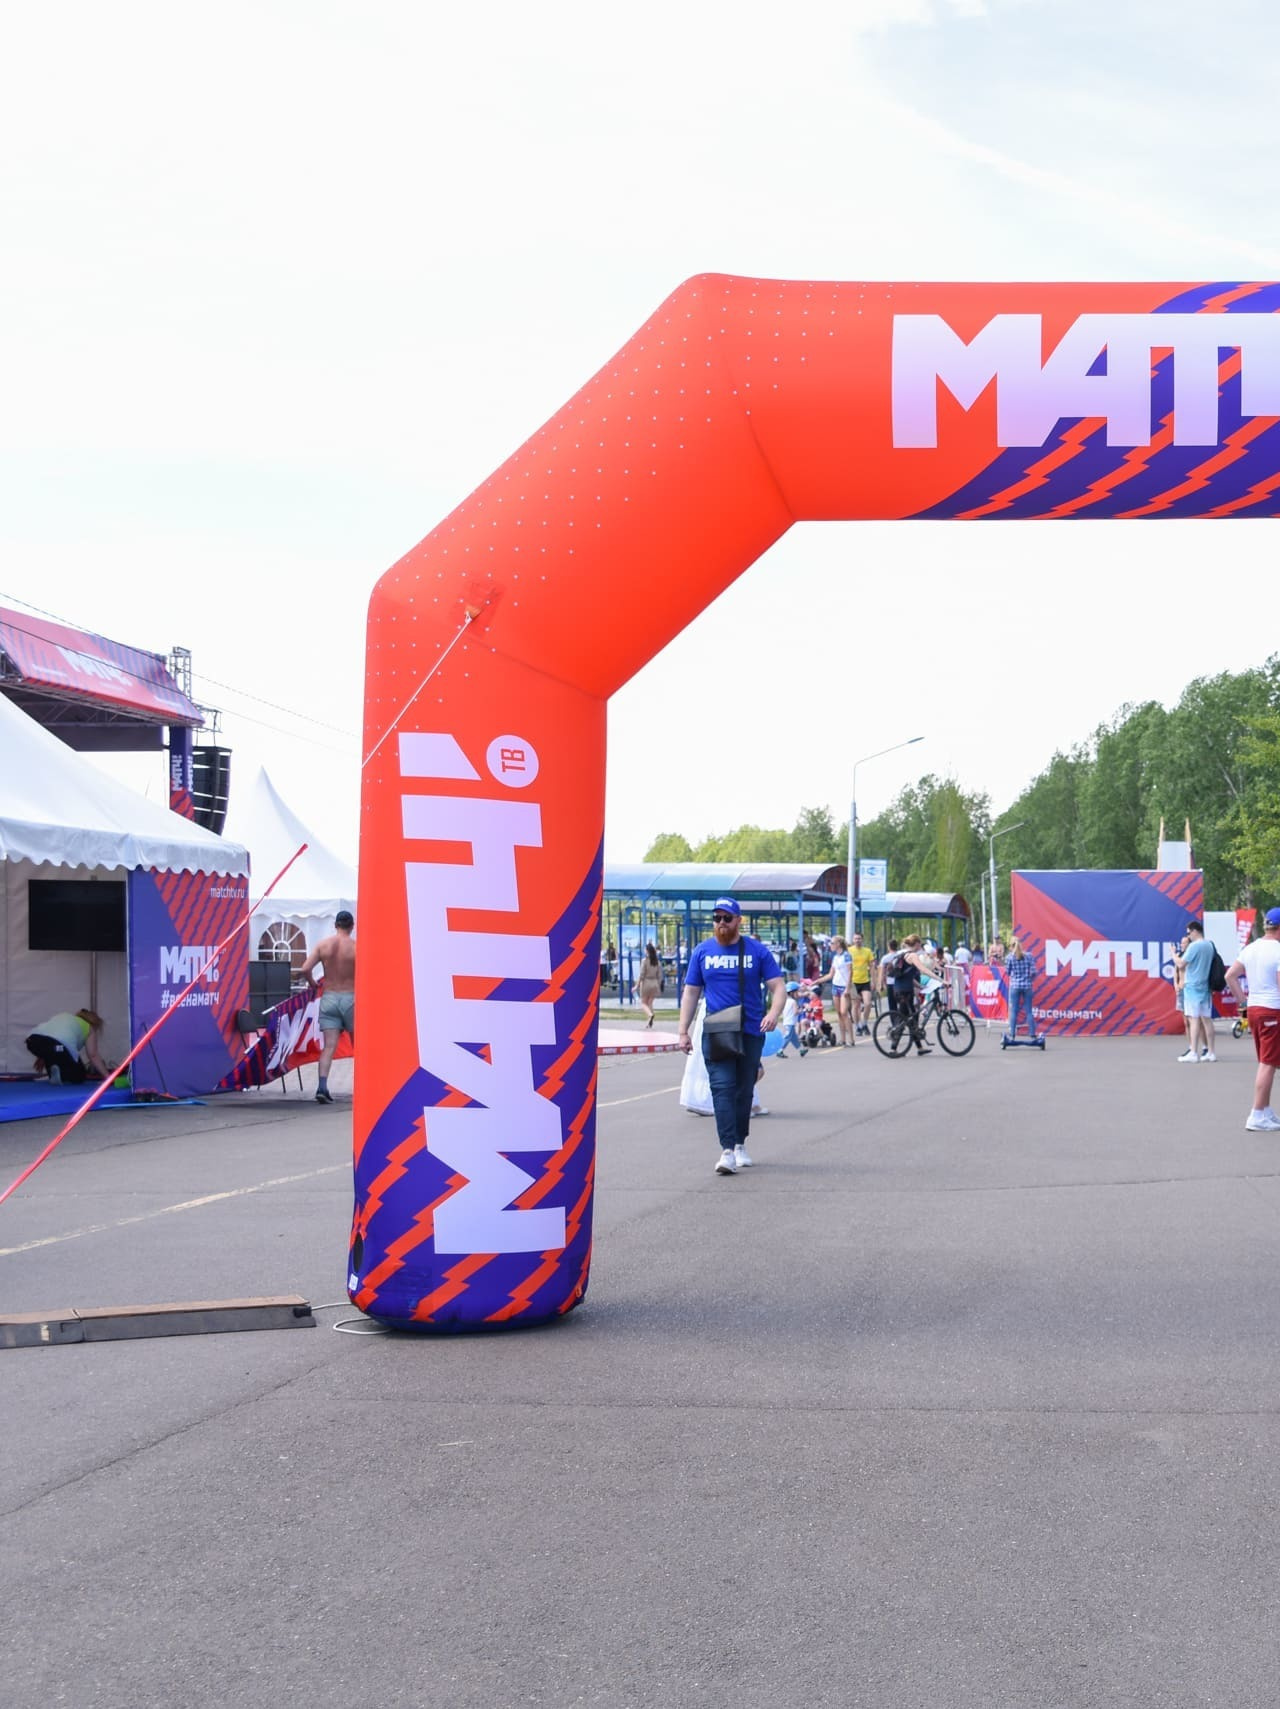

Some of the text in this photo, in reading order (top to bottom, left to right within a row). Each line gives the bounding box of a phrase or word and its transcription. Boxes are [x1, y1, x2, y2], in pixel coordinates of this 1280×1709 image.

[501, 748, 526, 773] ТВ
[210, 887, 245, 898] matchtv.ru
[160, 946, 219, 984] МАТЧ!
[1045, 939, 1175, 979] МАТЧ!
[398, 732, 566, 1254] МАТЧ!
